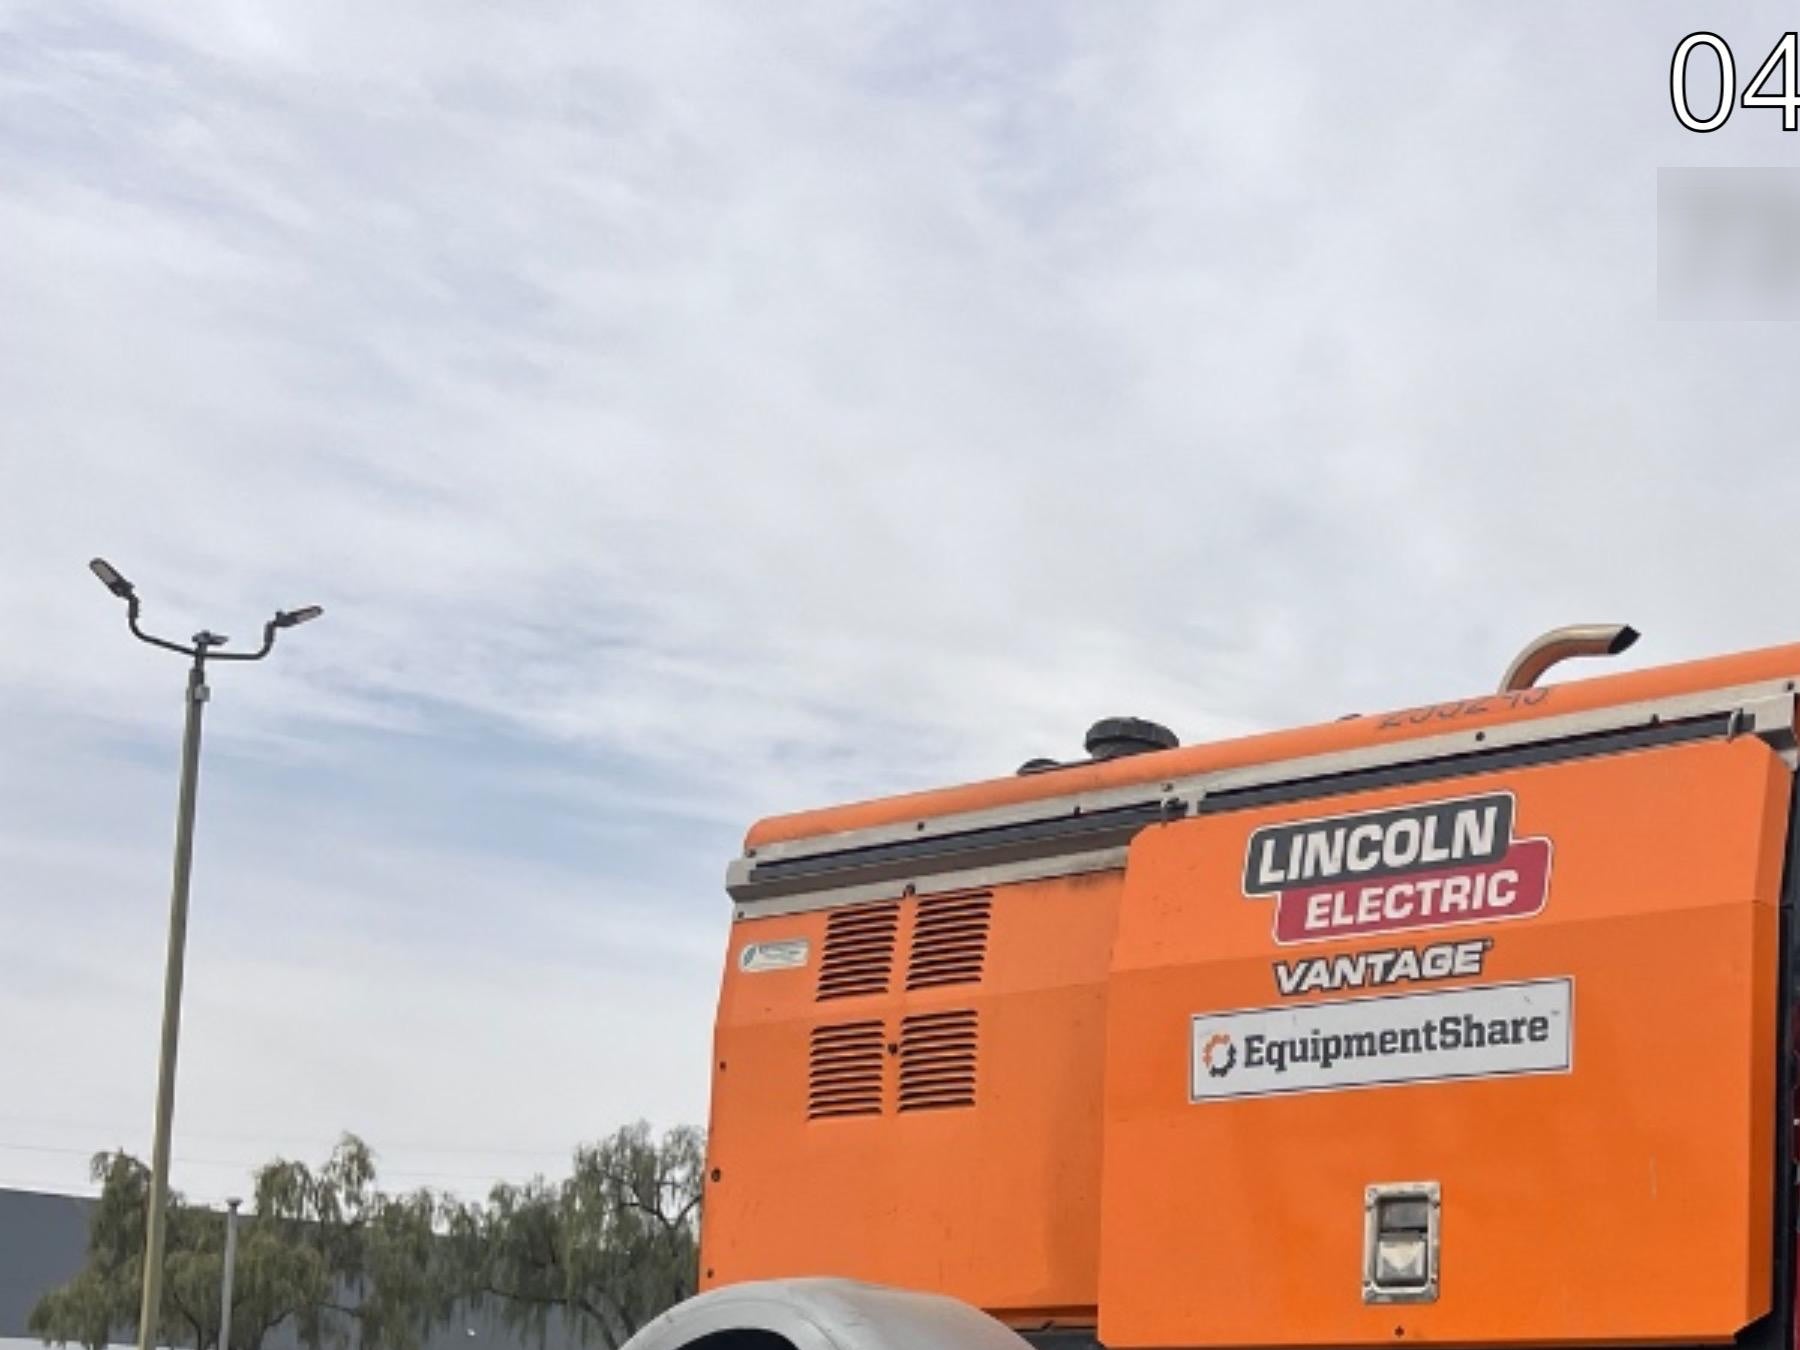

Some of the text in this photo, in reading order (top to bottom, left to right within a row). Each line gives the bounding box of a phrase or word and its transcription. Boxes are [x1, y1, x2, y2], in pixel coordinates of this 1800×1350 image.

[1258, 806, 1498, 885] LINCOLN
[1304, 869, 1519, 930] ELECTRIC
[1275, 940, 1484, 994] VANTAGE
[1243, 1014, 1549, 1071] EquipmentShare
